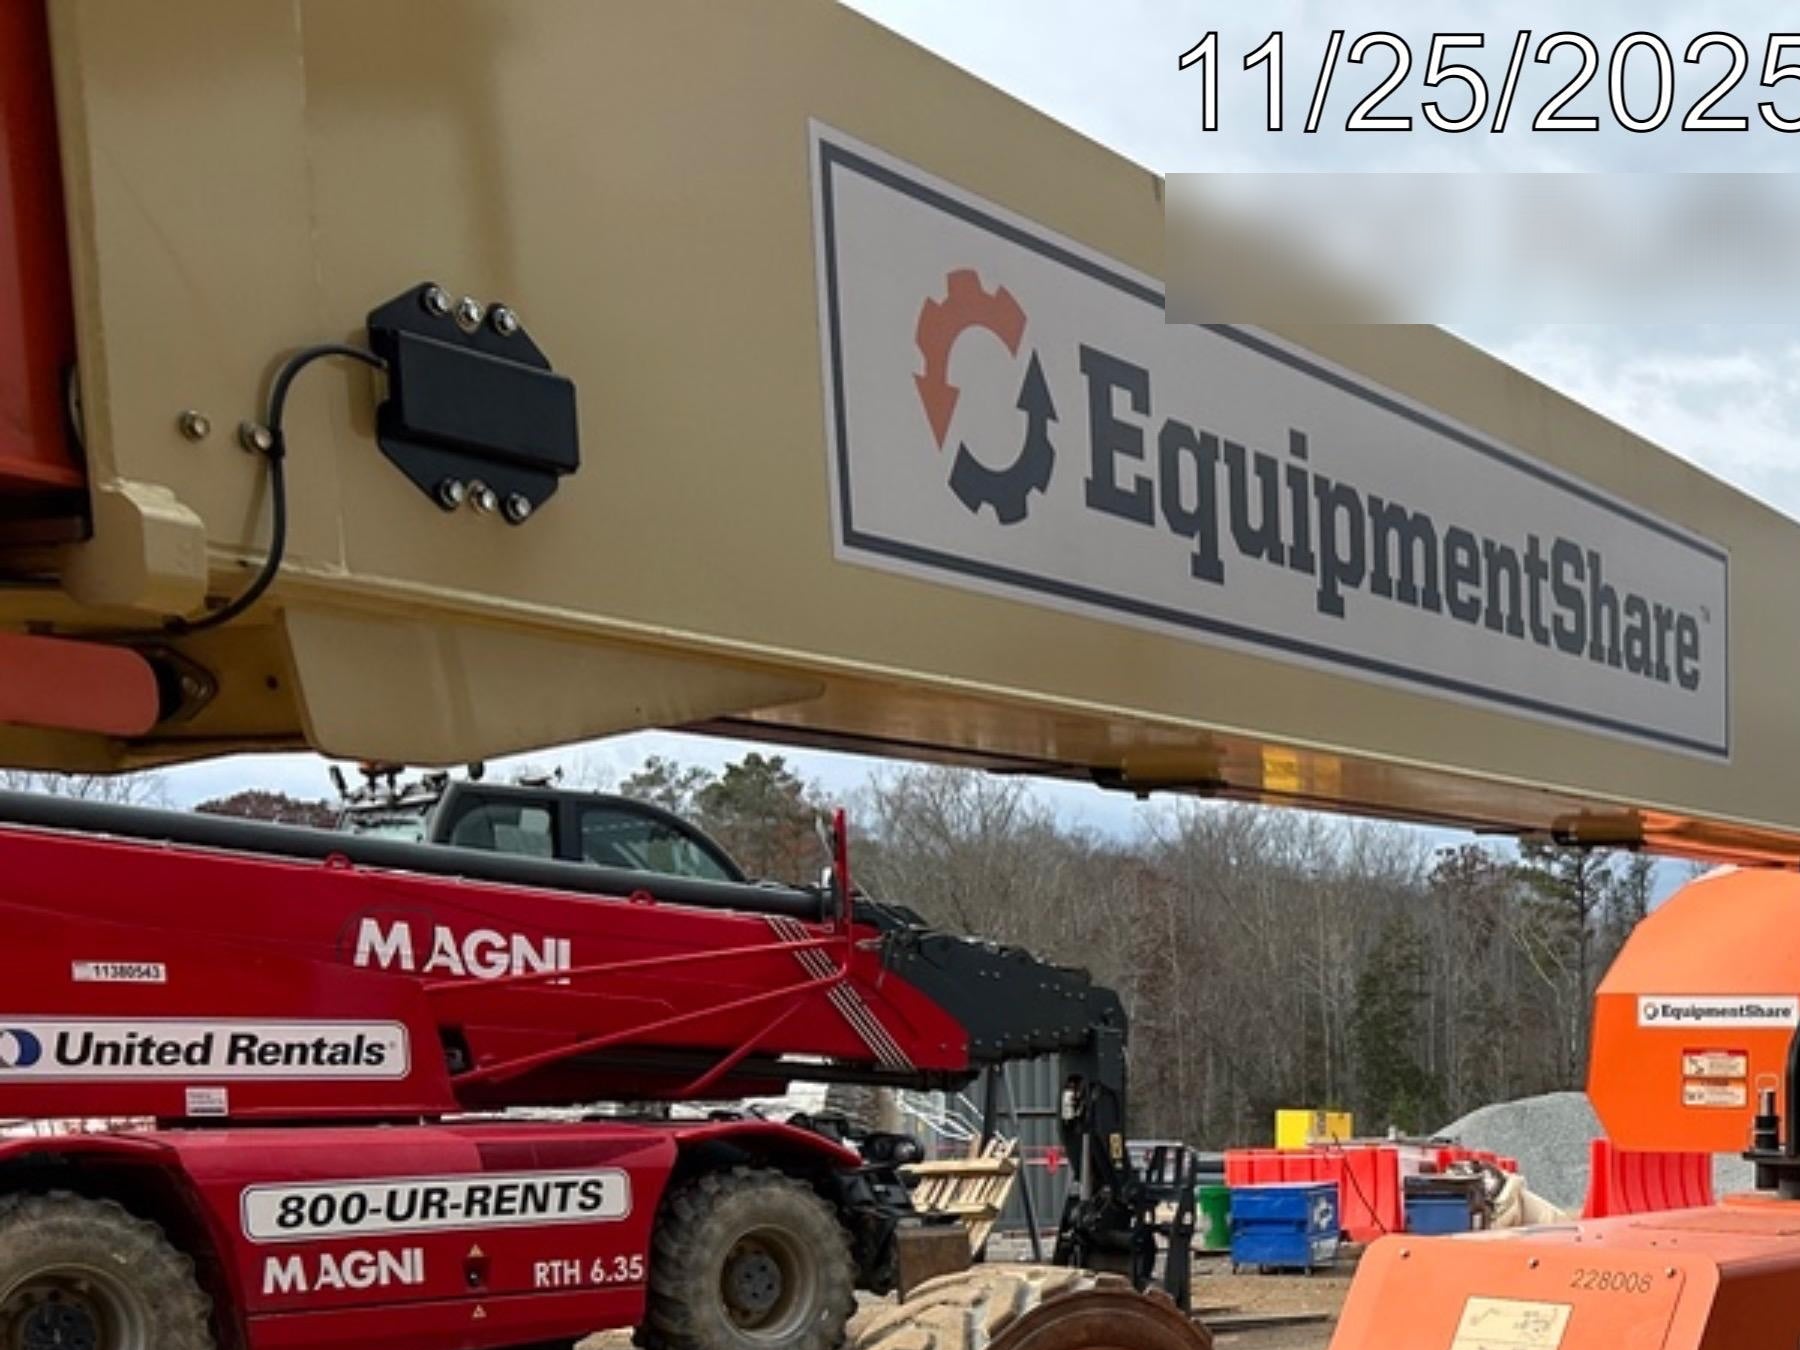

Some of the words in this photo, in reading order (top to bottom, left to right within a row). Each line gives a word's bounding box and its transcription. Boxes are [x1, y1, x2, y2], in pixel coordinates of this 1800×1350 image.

[1078, 342, 1702, 693] EquipmentShare
[1660, 1003, 1792, 1021] EquipmentShare
[55, 1031, 213, 1067] United
[226, 1033, 386, 1067] Rentals
[276, 1178, 604, 1230] 800-UR-RENTS
[533, 1259, 583, 1288] RTH
[589, 1254, 645, 1284] 6.35
